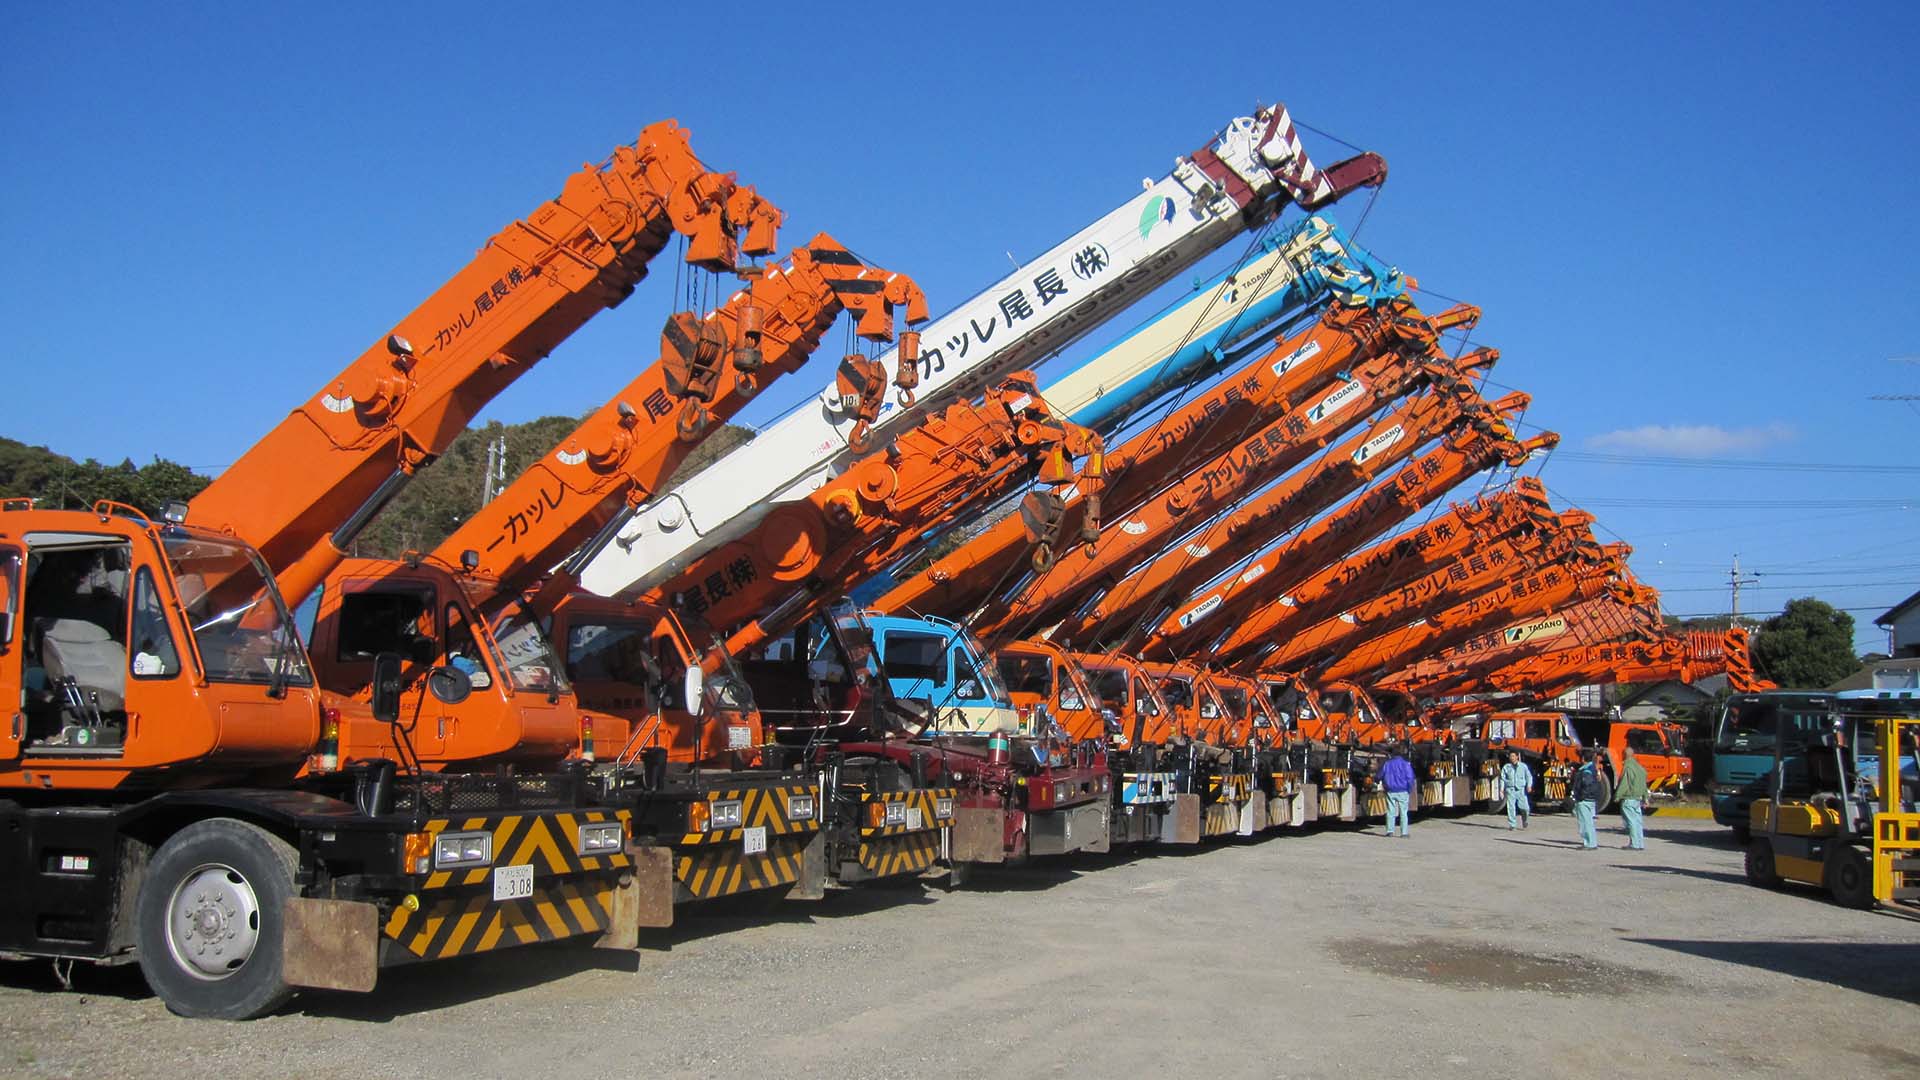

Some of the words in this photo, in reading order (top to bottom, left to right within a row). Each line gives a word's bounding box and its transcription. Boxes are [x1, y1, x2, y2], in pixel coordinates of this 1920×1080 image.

[892, 242, 1109, 386] カッレ尾長(株)
[1327, 382, 1359, 405] TADANO
[1371, 427, 1400, 447] TADANO
[1195, 596, 1220, 614] TADANO
[1528, 620, 1562, 632] TADANO
